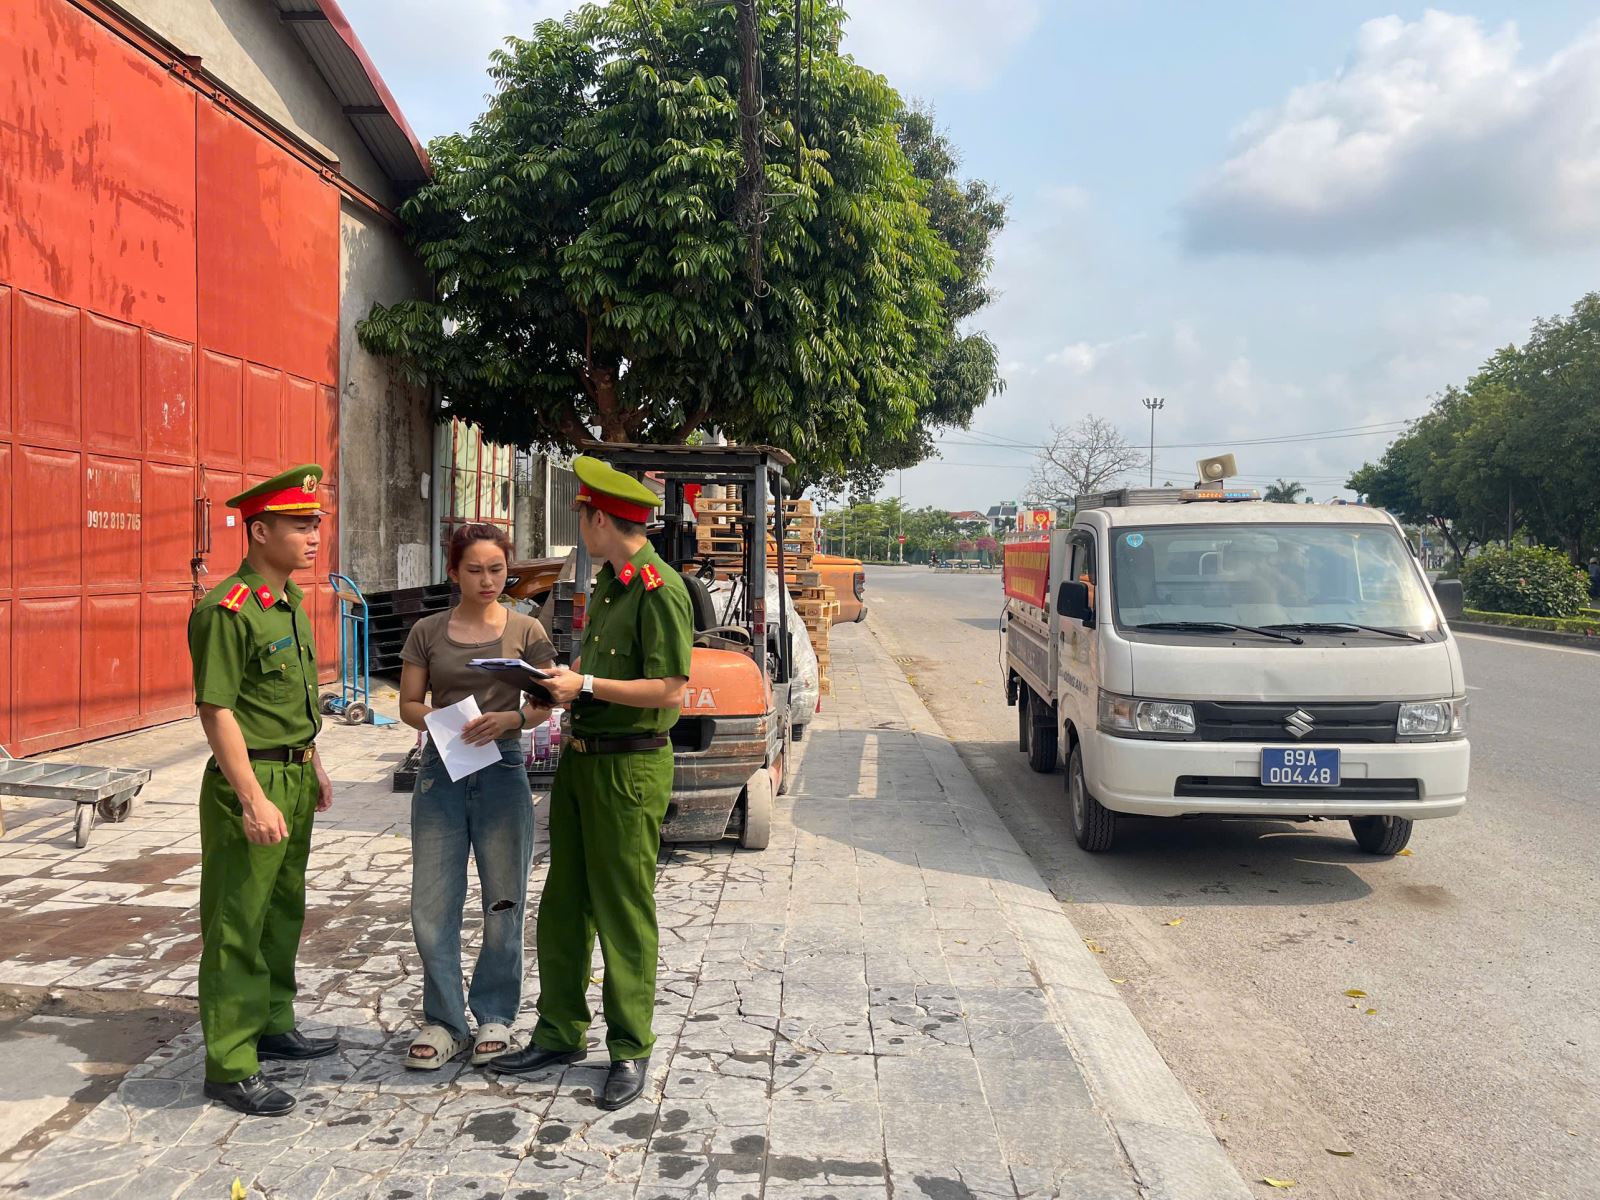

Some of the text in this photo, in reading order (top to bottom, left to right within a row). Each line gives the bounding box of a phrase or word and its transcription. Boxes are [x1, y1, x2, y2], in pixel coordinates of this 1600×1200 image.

[87, 510, 109, 528] 0912
[110, 512, 125, 530] 819
[1284, 750, 1317, 766] 89A
[1270, 767, 1330, 783] 004.48
